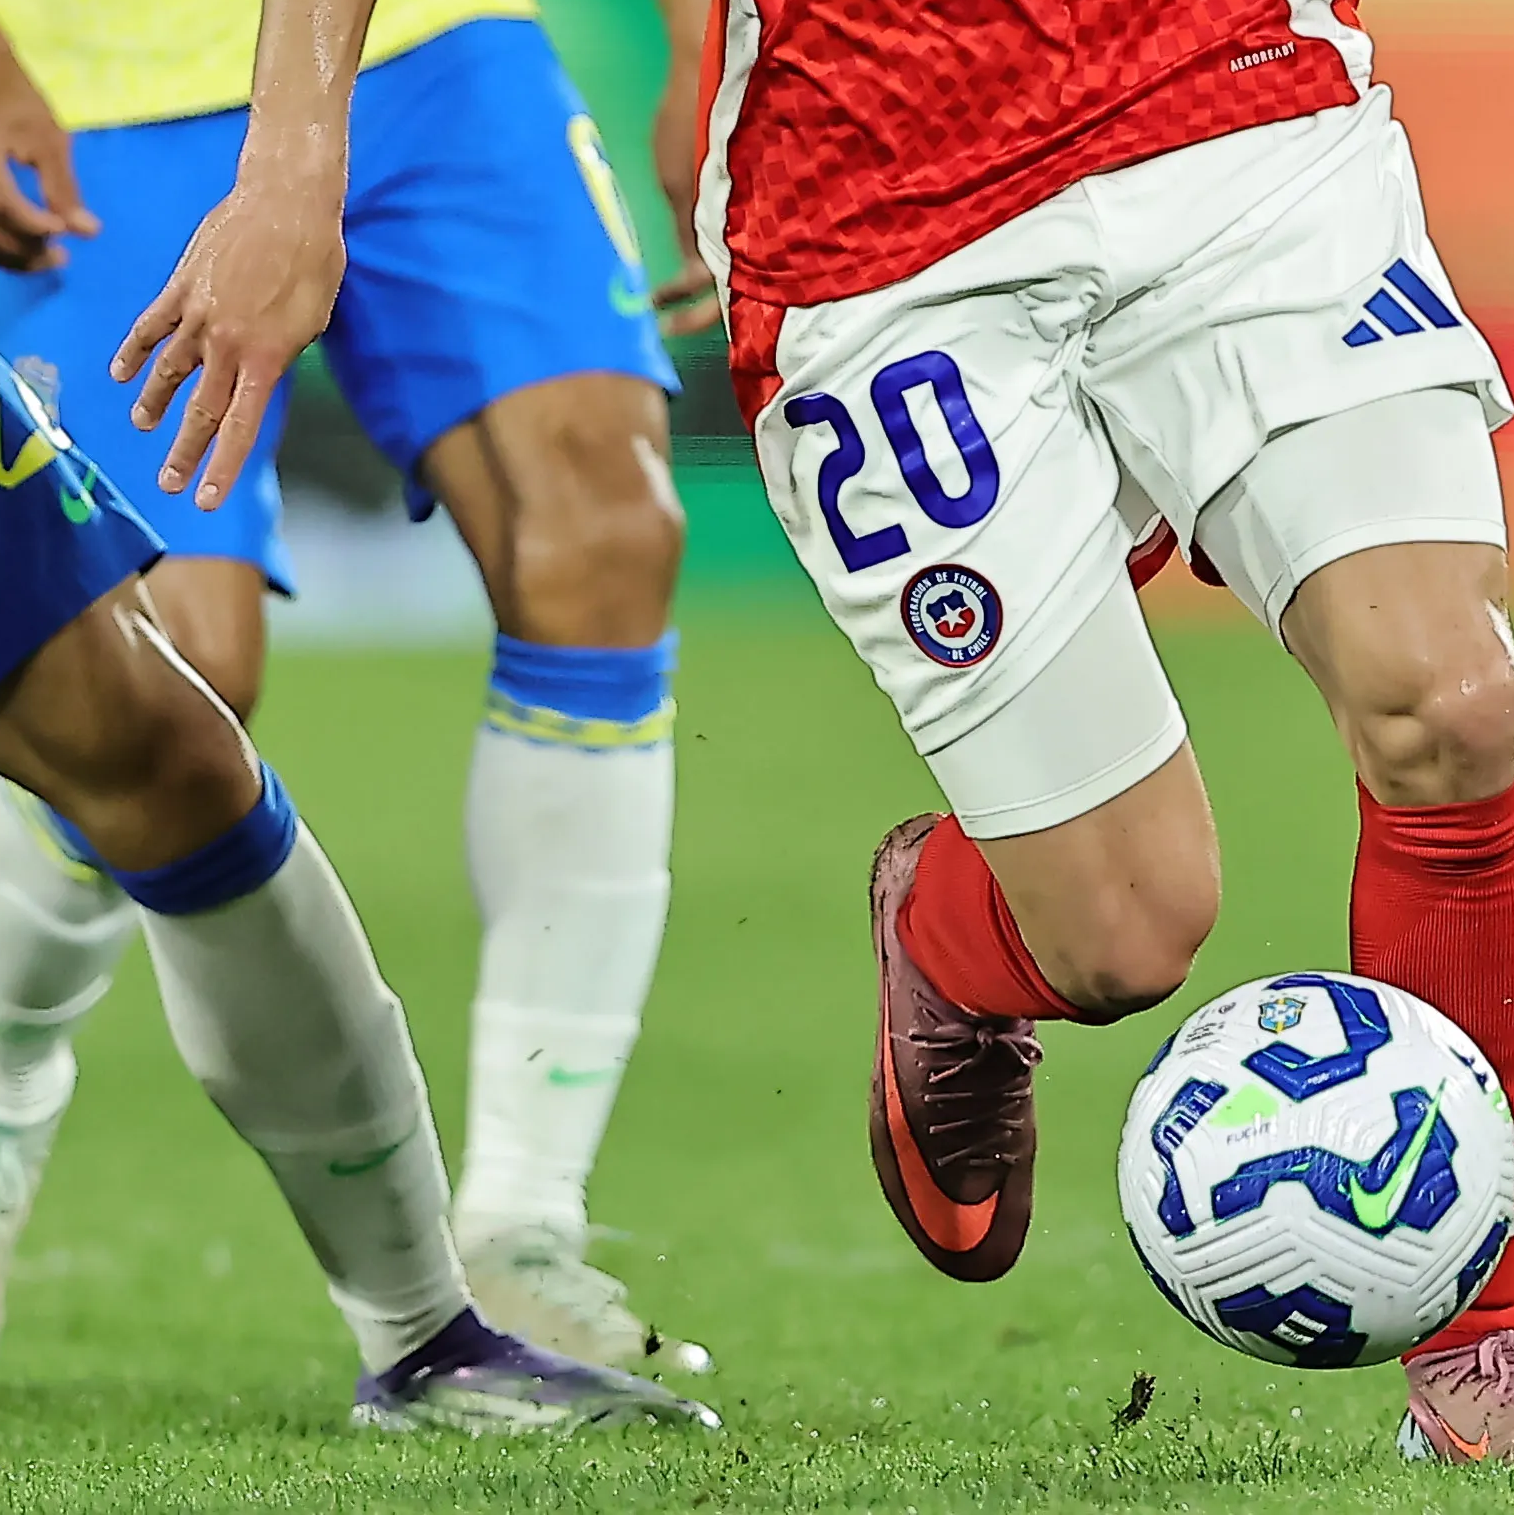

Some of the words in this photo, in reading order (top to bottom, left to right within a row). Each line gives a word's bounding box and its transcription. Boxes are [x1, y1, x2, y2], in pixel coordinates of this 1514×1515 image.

[1230, 41, 1295, 73] AEROREADY
[784, 349, 1001, 573] 20
[935, 572, 948, 583] DE
[952, 649, 965, 660] DE
